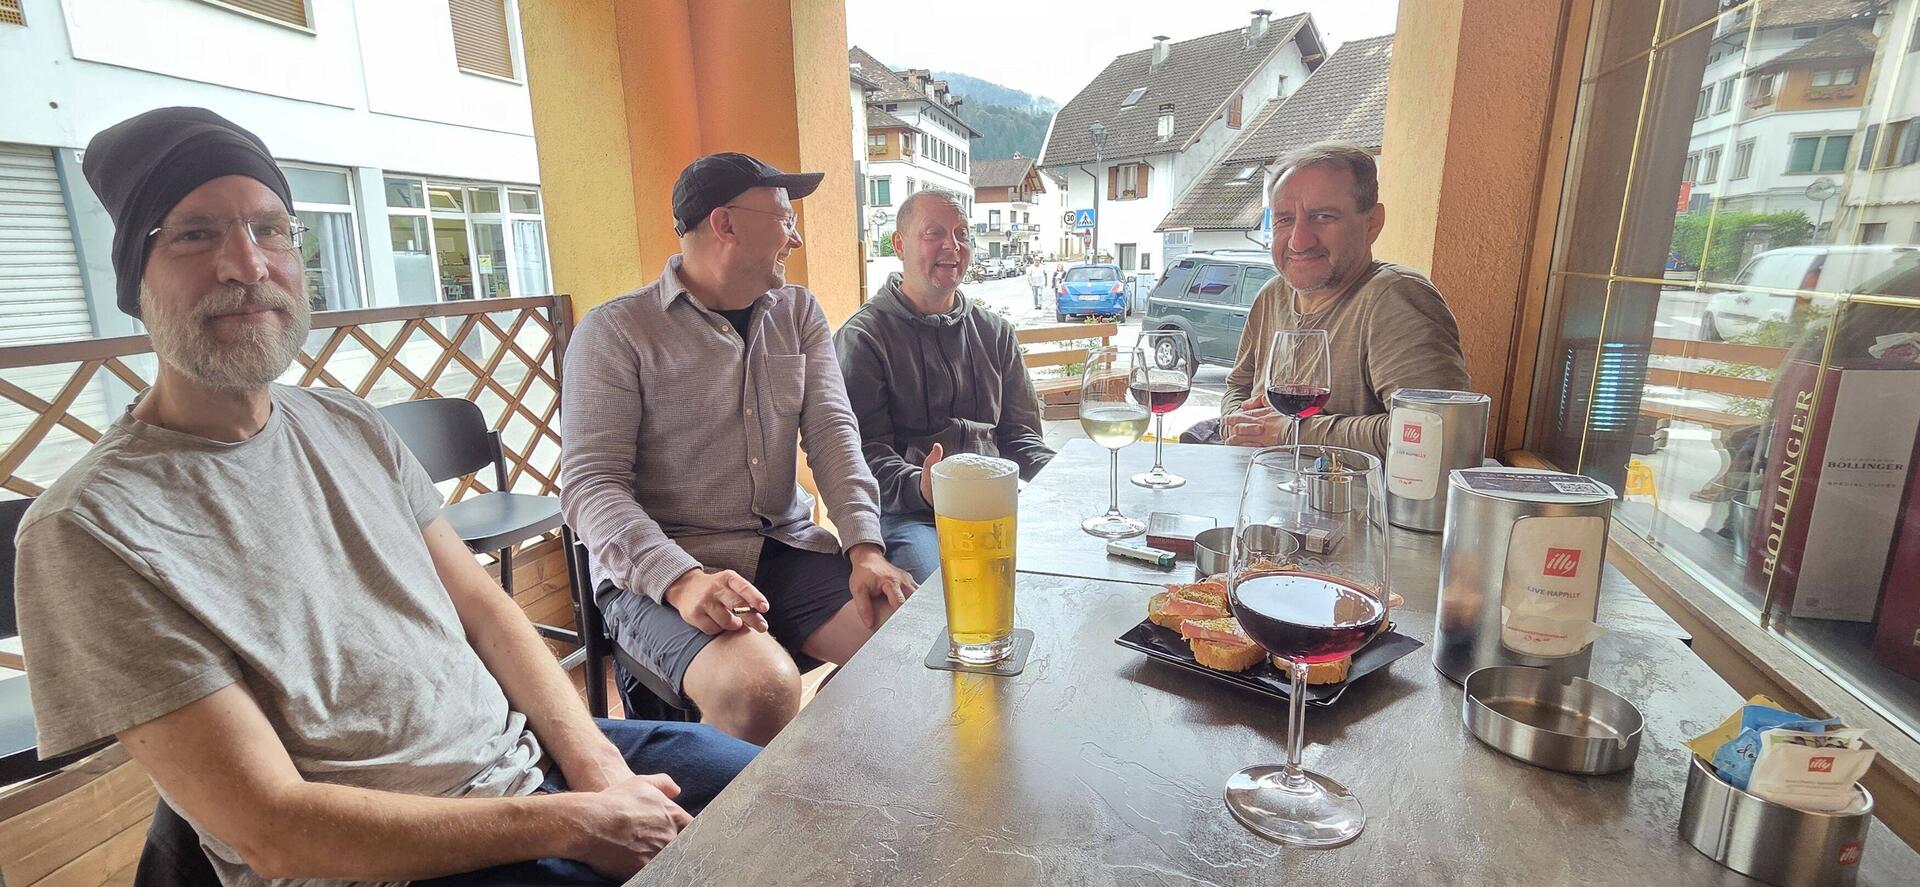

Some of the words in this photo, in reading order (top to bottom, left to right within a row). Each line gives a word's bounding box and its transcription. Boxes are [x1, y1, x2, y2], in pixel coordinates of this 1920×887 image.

[1403, 427, 1420, 441] illy
[1827, 461, 1904, 471] BOLLINGER
[1762, 390, 1813, 577] BOLLINGER
[1546, 552, 1577, 576] illy
[1527, 585, 1546, 596] LIVE
[1808, 757, 1831, 770] illy
[1839, 846, 1859, 863] illy
